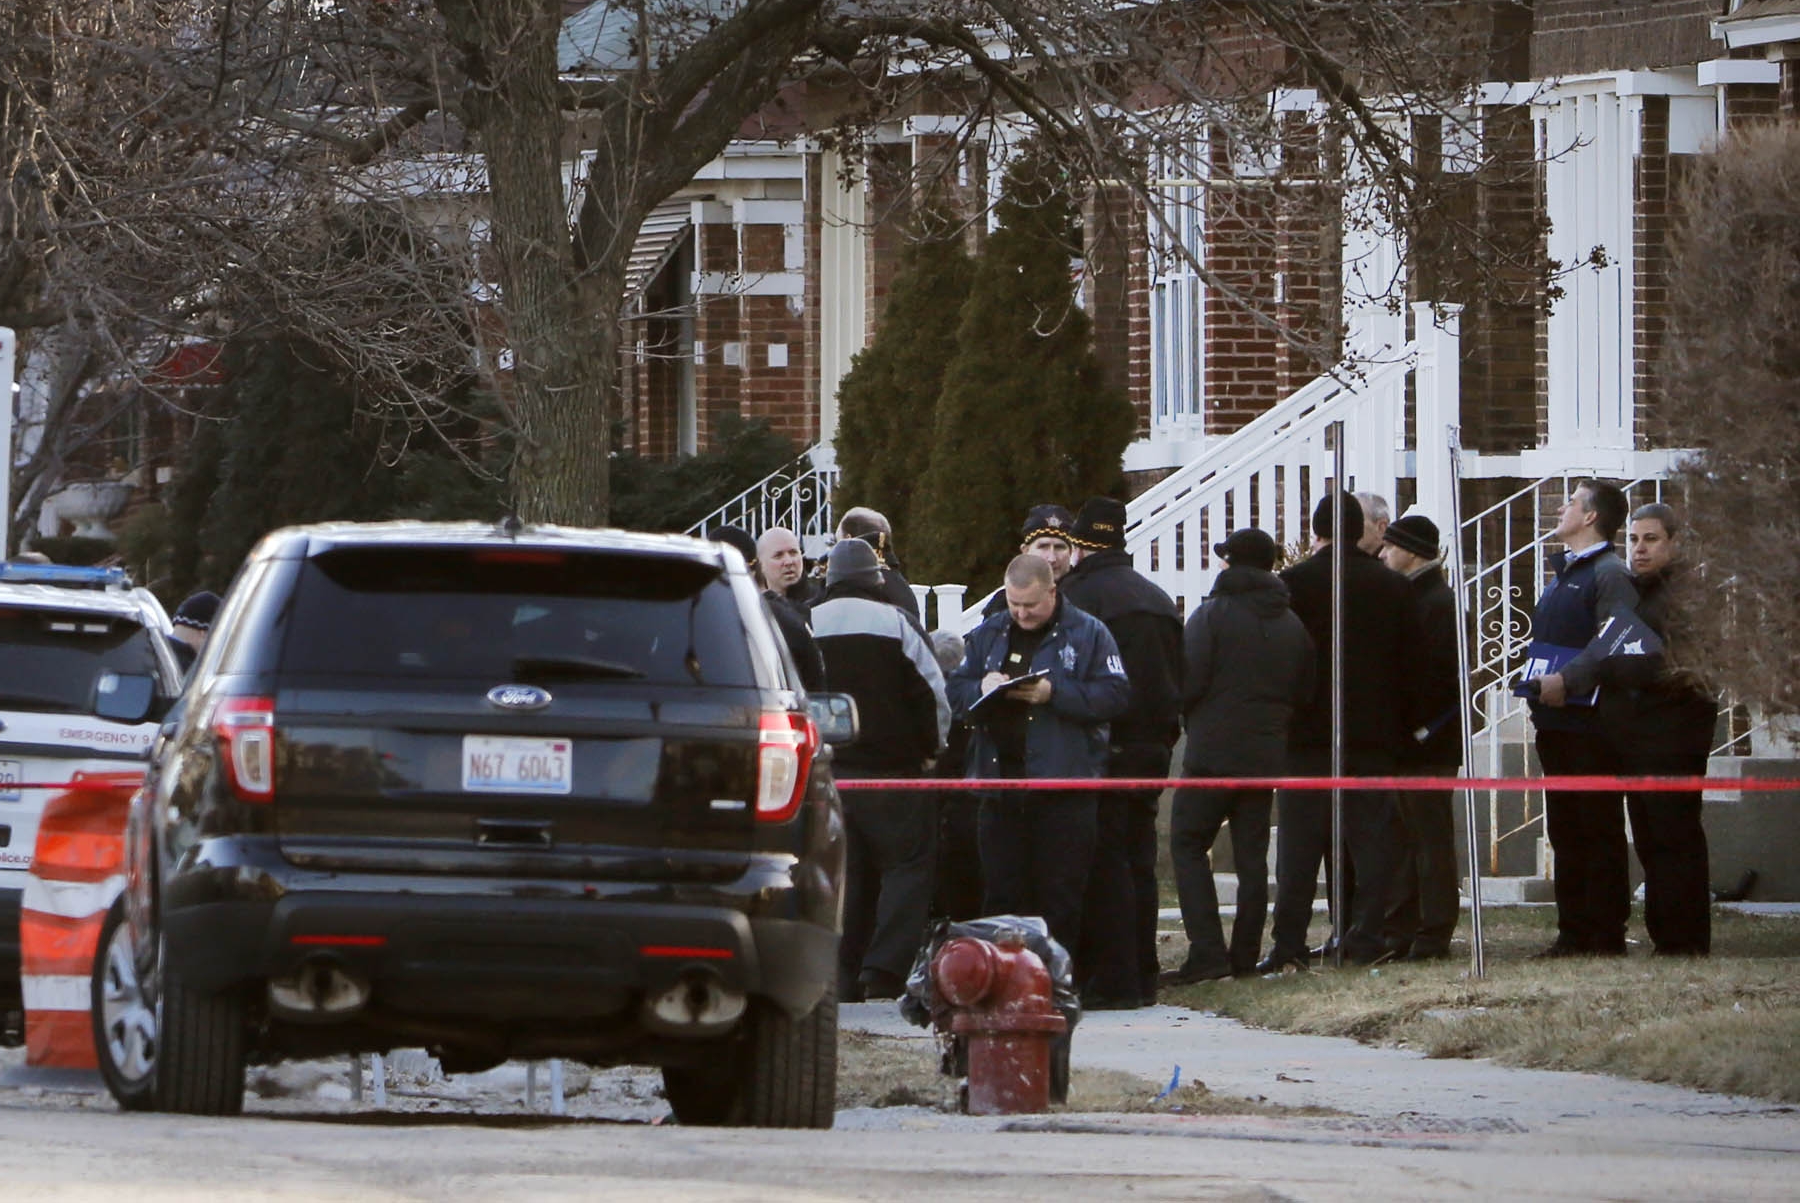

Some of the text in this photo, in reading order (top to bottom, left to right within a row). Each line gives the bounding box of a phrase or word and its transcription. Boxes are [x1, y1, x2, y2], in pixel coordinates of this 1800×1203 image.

[501, 689, 537, 705] Ford
[60, 727, 137, 744] EMERGENCY
[470, 753, 565, 782] N67 6043
